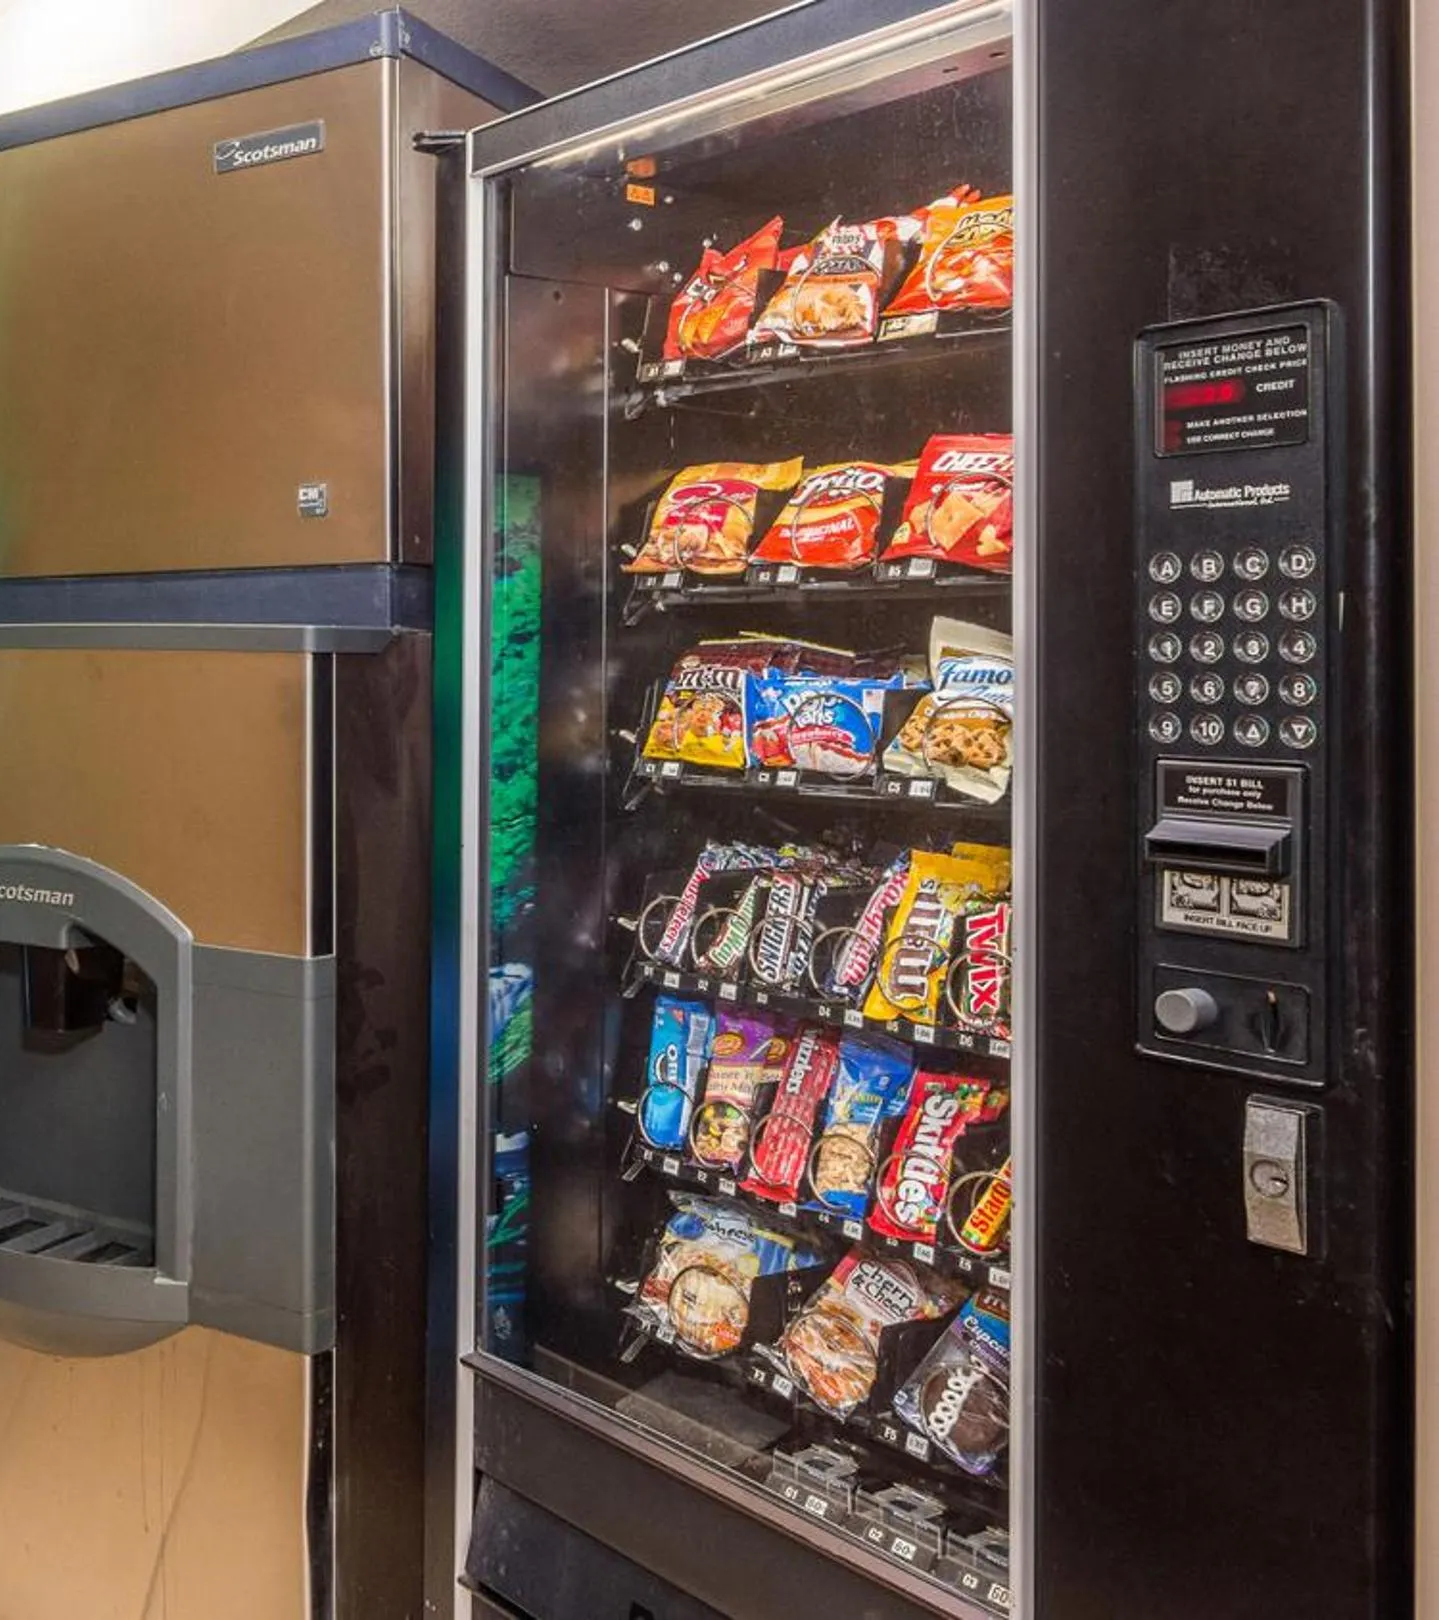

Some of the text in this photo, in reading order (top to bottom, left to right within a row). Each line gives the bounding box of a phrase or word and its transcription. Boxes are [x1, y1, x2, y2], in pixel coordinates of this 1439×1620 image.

[233, 138, 317, 166] Scotsman
[1179, 336, 1290, 360] INSERT MONEY AND
[1164, 343, 1307, 370] RECEIVE CHANGE BELOW
[1164, 358, 1307, 384] FLASHING CREDIT CHECK PRICE
[1256, 379, 1296, 393] CREDIT
[1186, 409, 1308, 429] MAKE ANOTHER SELECTION
[1203, 431, 1240, 442] CORRECT
[1241, 428, 1275, 439] CHANGE
[1194, 482, 1291, 501] Automatic Products
[1161, 560, 1174, 577] A
[1202, 558, 1217, 574] B
[1246, 556, 1261, 573] C
[1291, 554, 1306, 571] D
[1161, 600, 1173, 616] E
[1203, 599, 1215, 614] F
[1246, 598, 1261, 615] G
[1292, 597, 1307, 614] H
[1203, 641, 1216, 656] 2
[1292, 640, 1306, 655] 4
[1162, 681, 1173, 696] 5
[1203, 681, 1216, 696] 6
[1293, 682, 1306, 697] 8
[1162, 721, 1173, 736] 9
[1200, 721, 1219, 737] 10
[1185, 775, 1263, 790] INSERT $1 BILL
[1188, 785, 1262, 800] for purchase only
[1177, 795, 1273, 811] Receive Change Below
[1183, 914, 1214, 925] INSERT
[1216, 917, 1233, 928] BILL
[1236, 920, 1258, 931] FACE
